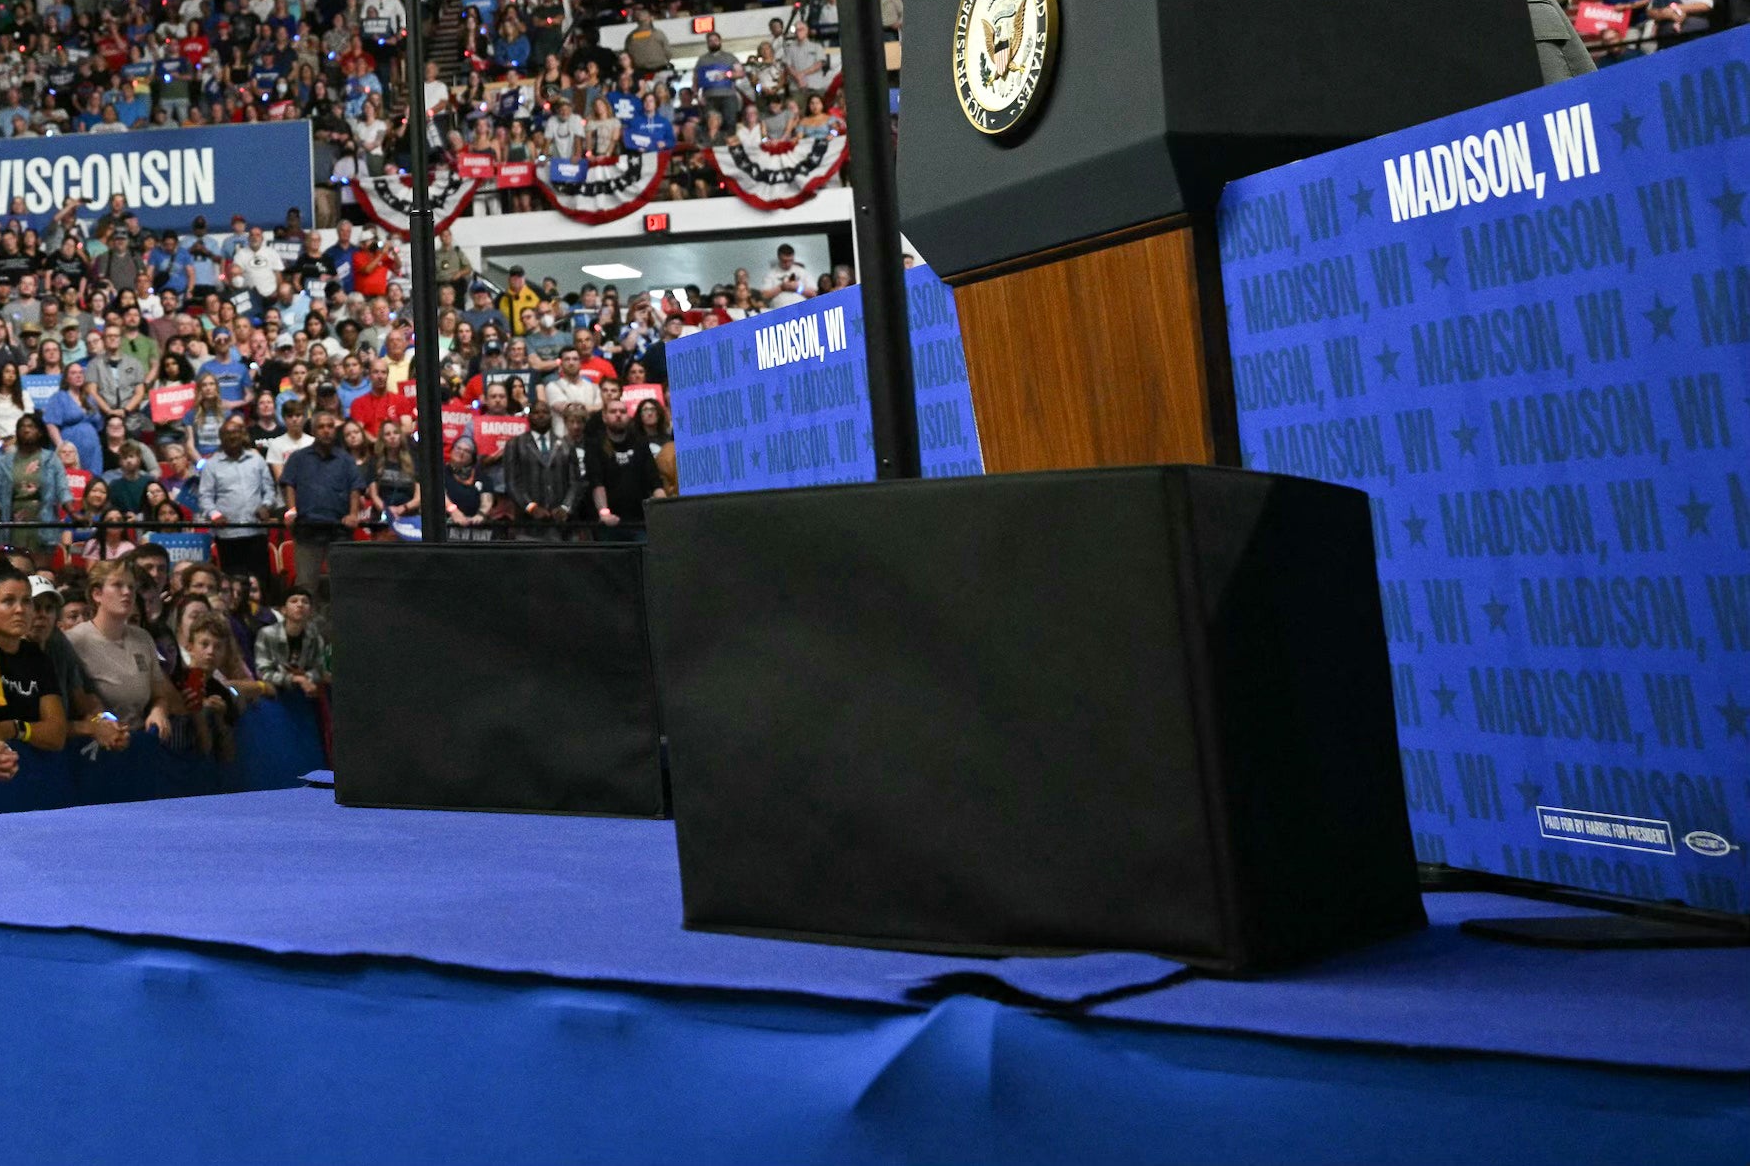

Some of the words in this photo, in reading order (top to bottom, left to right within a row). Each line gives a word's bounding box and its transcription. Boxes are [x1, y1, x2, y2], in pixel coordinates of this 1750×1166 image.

[962, 88, 988, 129] VICE
[1017, 32, 1046, 110] STATES
[1383, 121, 1547, 223] MADISON,
[1544, 102, 1601, 182] WI
[1240, 254, 1369, 333] MADISON,
[1369, 241, 1414, 308] WI
[1462, 193, 1635, 291] MADISON,
[1636, 176, 1696, 257] WI
[755, 313, 825, 370] MADISON,
[824, 306, 847, 353] WI
[1323, 336, 1366, 399] WI
[1411, 300, 1574, 387] MADISON,
[1574, 287, 1631, 364] WI
[481, 421, 527, 436] BADGERS
[789, 361, 861, 417] MADISON,
[1263, 414, 1395, 486] MADISON,
[1394, 408, 1442, 474] WI
[1490, 380, 1670, 466] MADISON,
[1669, 372, 1731, 450] WI
[765, 423, 836, 475] MADISON,
[834, 418, 858, 464] WI
[1439, 483, 1608, 566] MADISON,
[1606, 477, 1666, 553] WI
[1422, 578, 1472, 645] WI
[1521, 575, 1707, 663] MADISON,
[1469, 665, 1645, 756] MADISON,
[1643, 674, 1704, 750] WI
[1453, 751, 1505, 823] WI
[1543, 814, 1560, 831] PAID
[1560, 816, 1574, 832] FOR
[1573, 818, 1585, 834] BY
[1585, 820, 1613, 838] HARRIS
[1612, 823, 1627, 840] FOR
[1627, 826, 1666, 845] PRESIDENT
